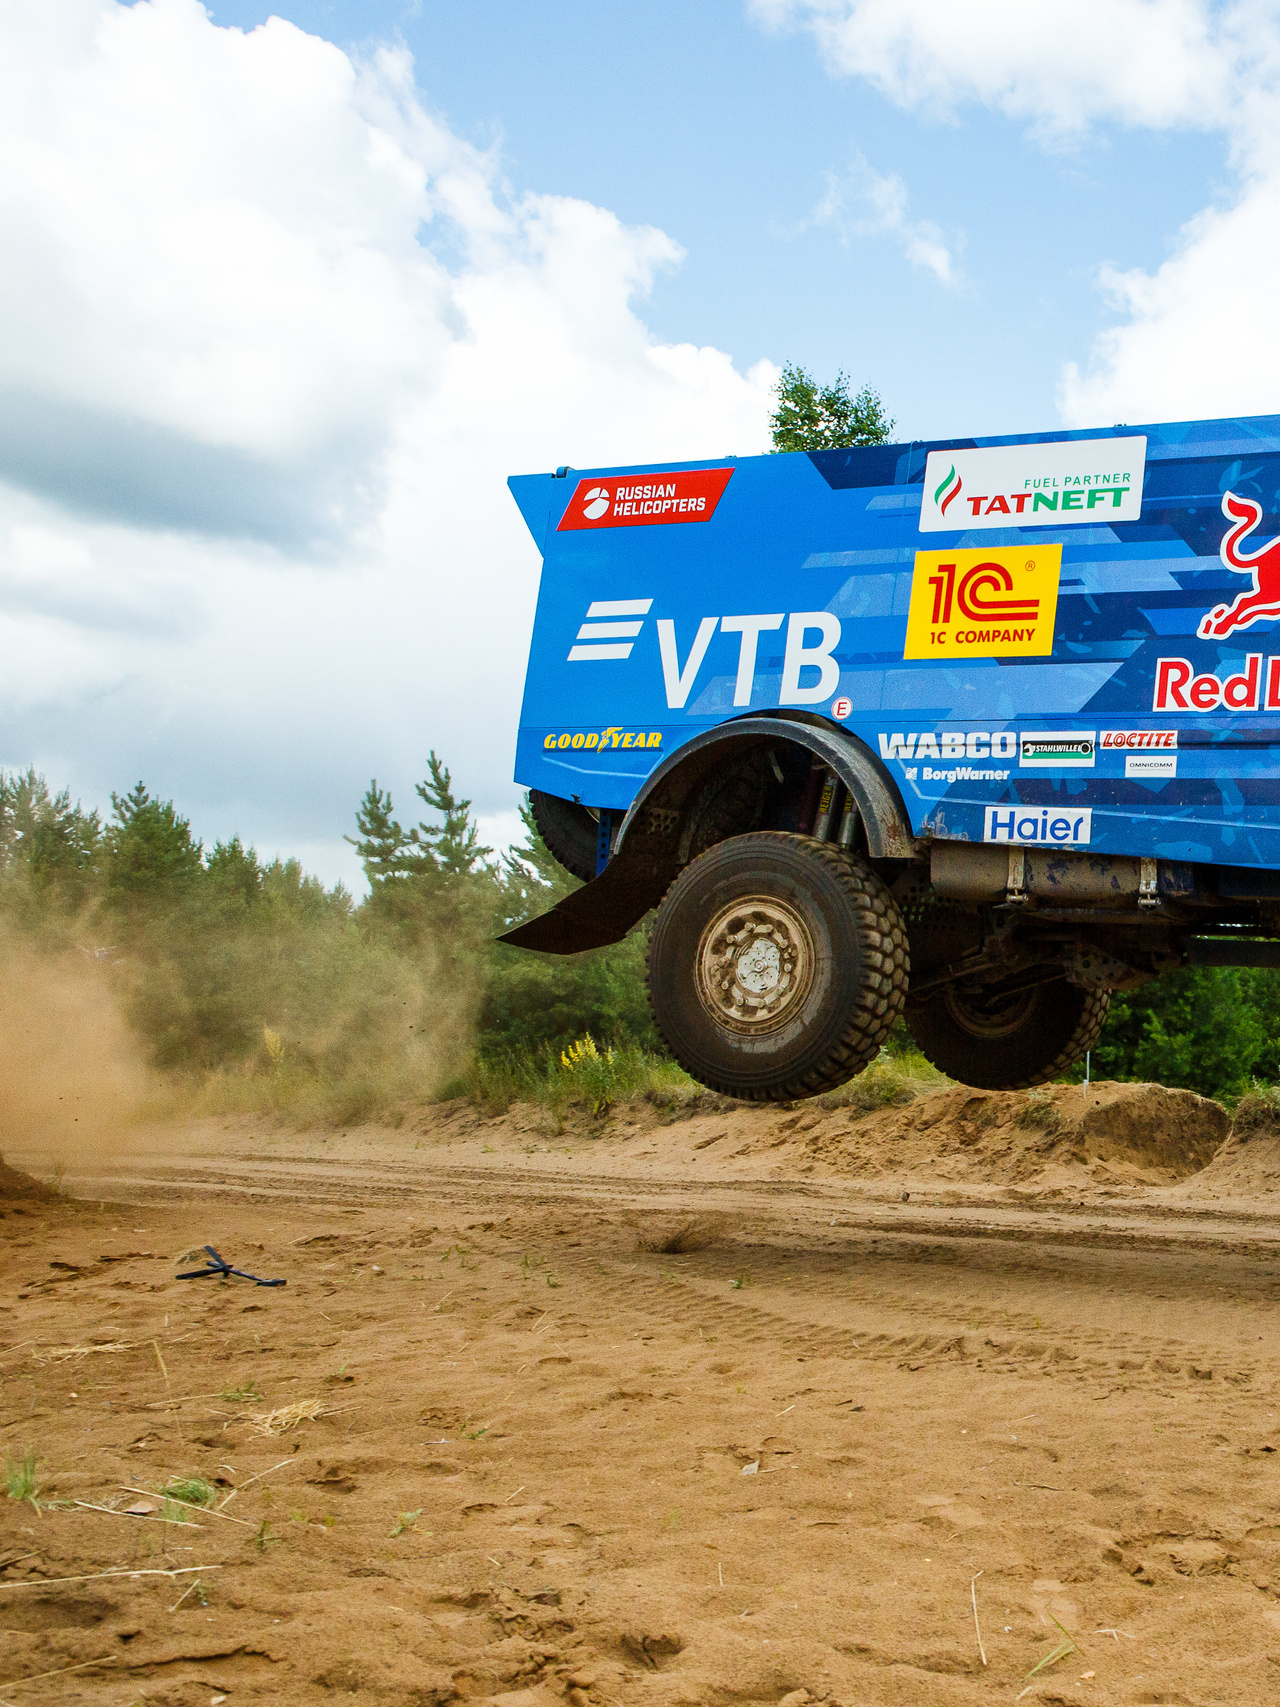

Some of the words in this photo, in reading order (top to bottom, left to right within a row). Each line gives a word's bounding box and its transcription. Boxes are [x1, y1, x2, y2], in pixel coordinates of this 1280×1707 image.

[1024, 479, 1059, 489] FUEL
[1064, 473, 1131, 487] PARTNER
[615, 483, 676, 502] RUSSIAN
[967, 487, 1130, 516] TATNEFT
[613, 497, 706, 516] HELICOPTERS
[930, 632, 946, 645] 1C
[955, 629, 1036, 644] COMPANY
[656, 611, 842, 709] VTB
[1154, 655, 1261, 711] Red
[836, 702, 848, 717] E
[878, 732, 1017, 760] WABCO
[1103, 732, 1174, 747] LOCTITE
[923, 767, 1010, 783] BorgWarner
[991, 810, 1085, 841] Haier
